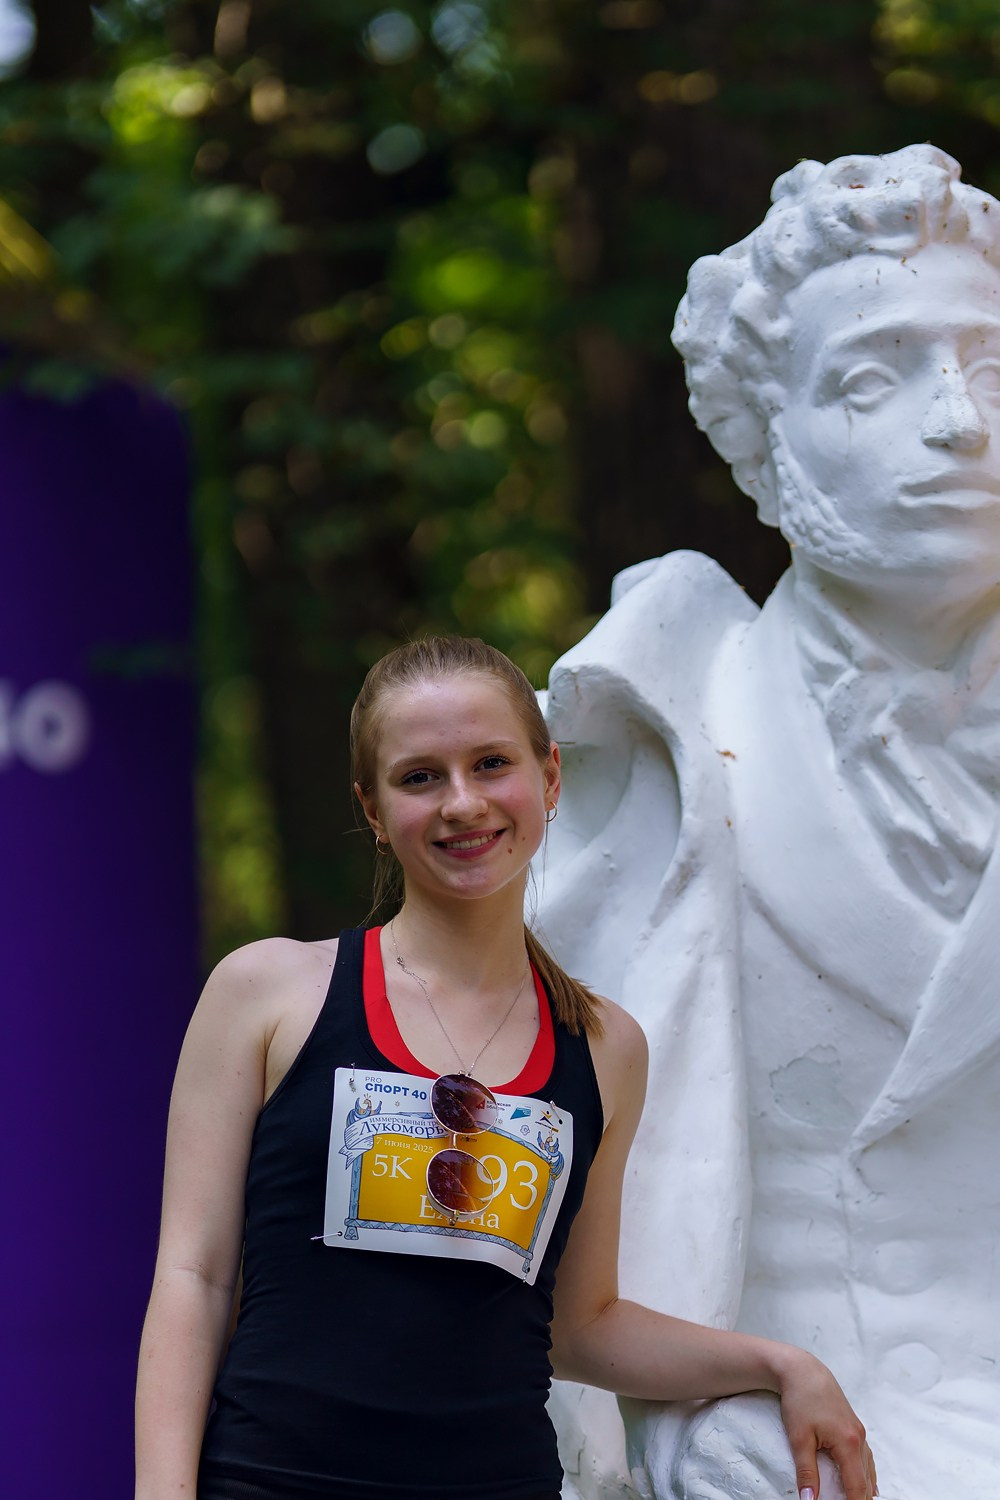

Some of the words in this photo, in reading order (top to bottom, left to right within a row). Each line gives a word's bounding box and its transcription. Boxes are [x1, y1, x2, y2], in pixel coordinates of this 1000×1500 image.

[365, 1076, 382, 1084] PRO
[365, 1082, 410, 1097] СПОРТ
[411, 1089, 427, 1101] 40
[359, 1121, 445, 1139] Лукоморь
[376, 1136, 382, 1145] 7
[384, 1139, 411, 1149] июня
[413, 1143, 434, 1154] 2025
